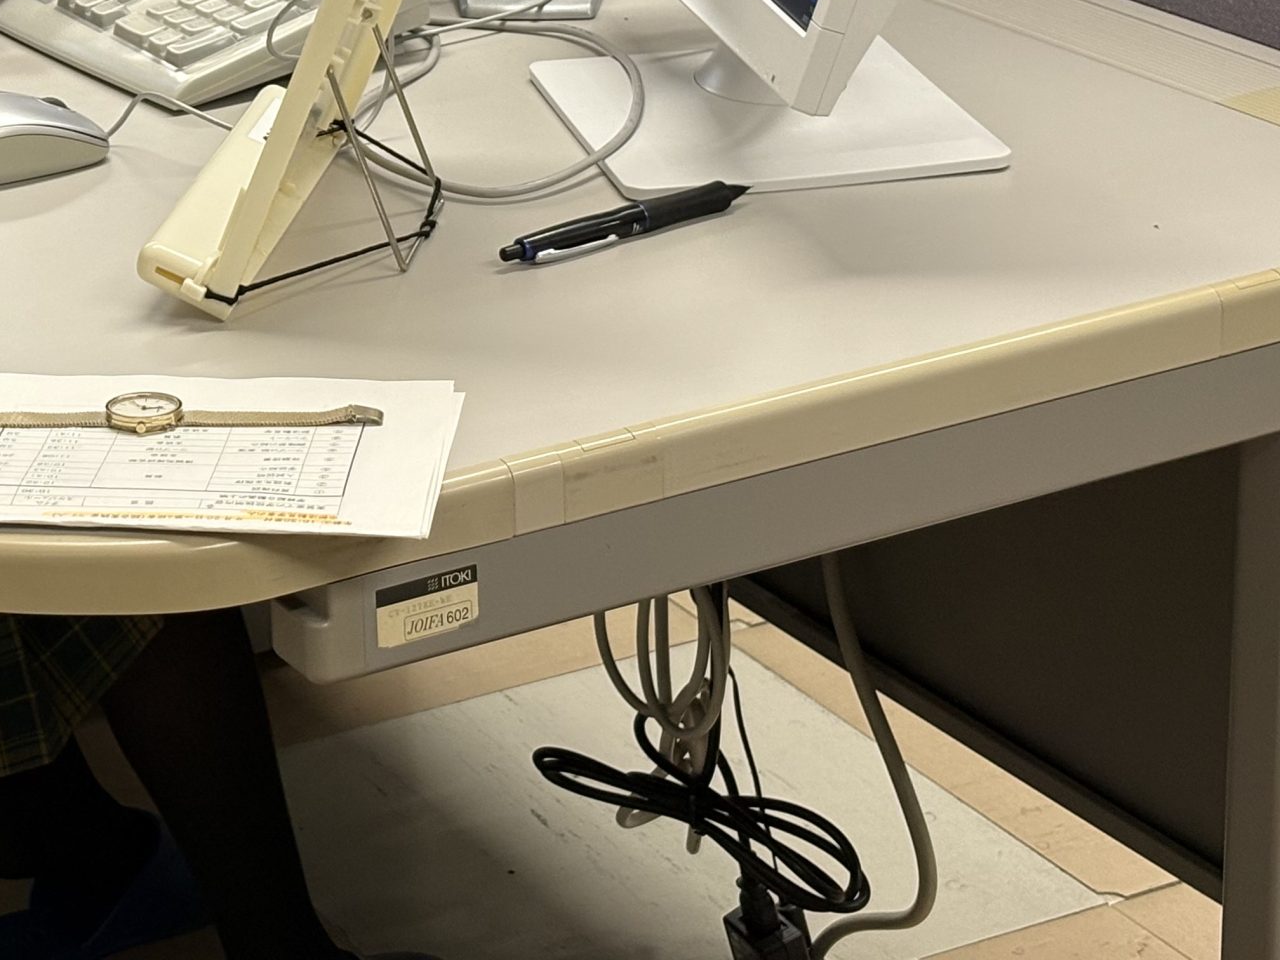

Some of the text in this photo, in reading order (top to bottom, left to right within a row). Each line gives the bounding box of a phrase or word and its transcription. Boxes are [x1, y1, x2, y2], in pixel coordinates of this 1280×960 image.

[441, 569, 471, 588] ITOKI
[407, 606, 469, 635] JOIFA 602
